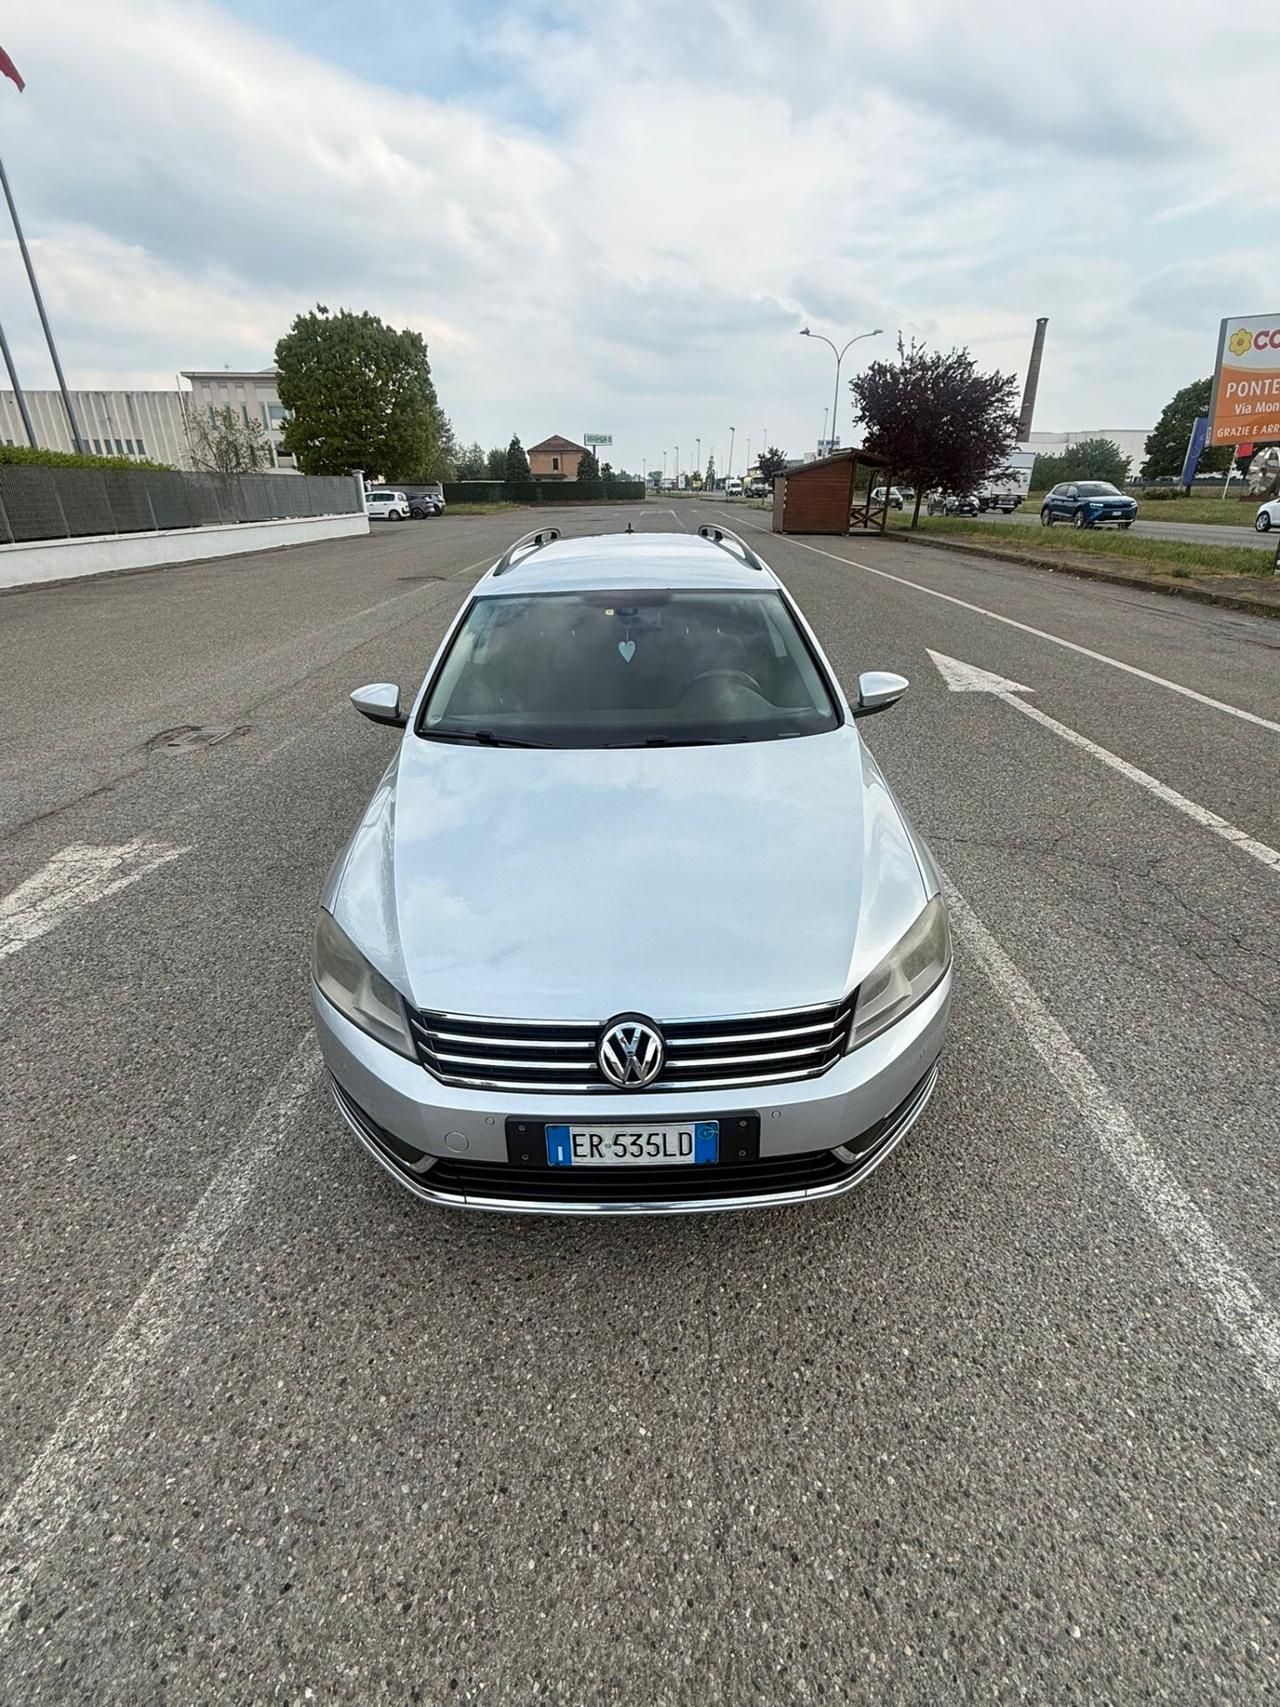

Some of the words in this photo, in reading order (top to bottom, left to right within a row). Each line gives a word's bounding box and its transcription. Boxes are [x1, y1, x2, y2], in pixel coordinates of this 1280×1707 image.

[1226, 379, 1280, 398] PONTE
[1235, 402, 1252, 415] Via
[1255, 401, 1280, 413] Mon
[1217, 426, 1250, 438] GRAZIE
[1252, 425, 1260, 435] E
[1260, 424, 1280, 435] ARR
[572, 1133, 604, 1158] ER
[613, 1131, 693, 1158] 535LD
